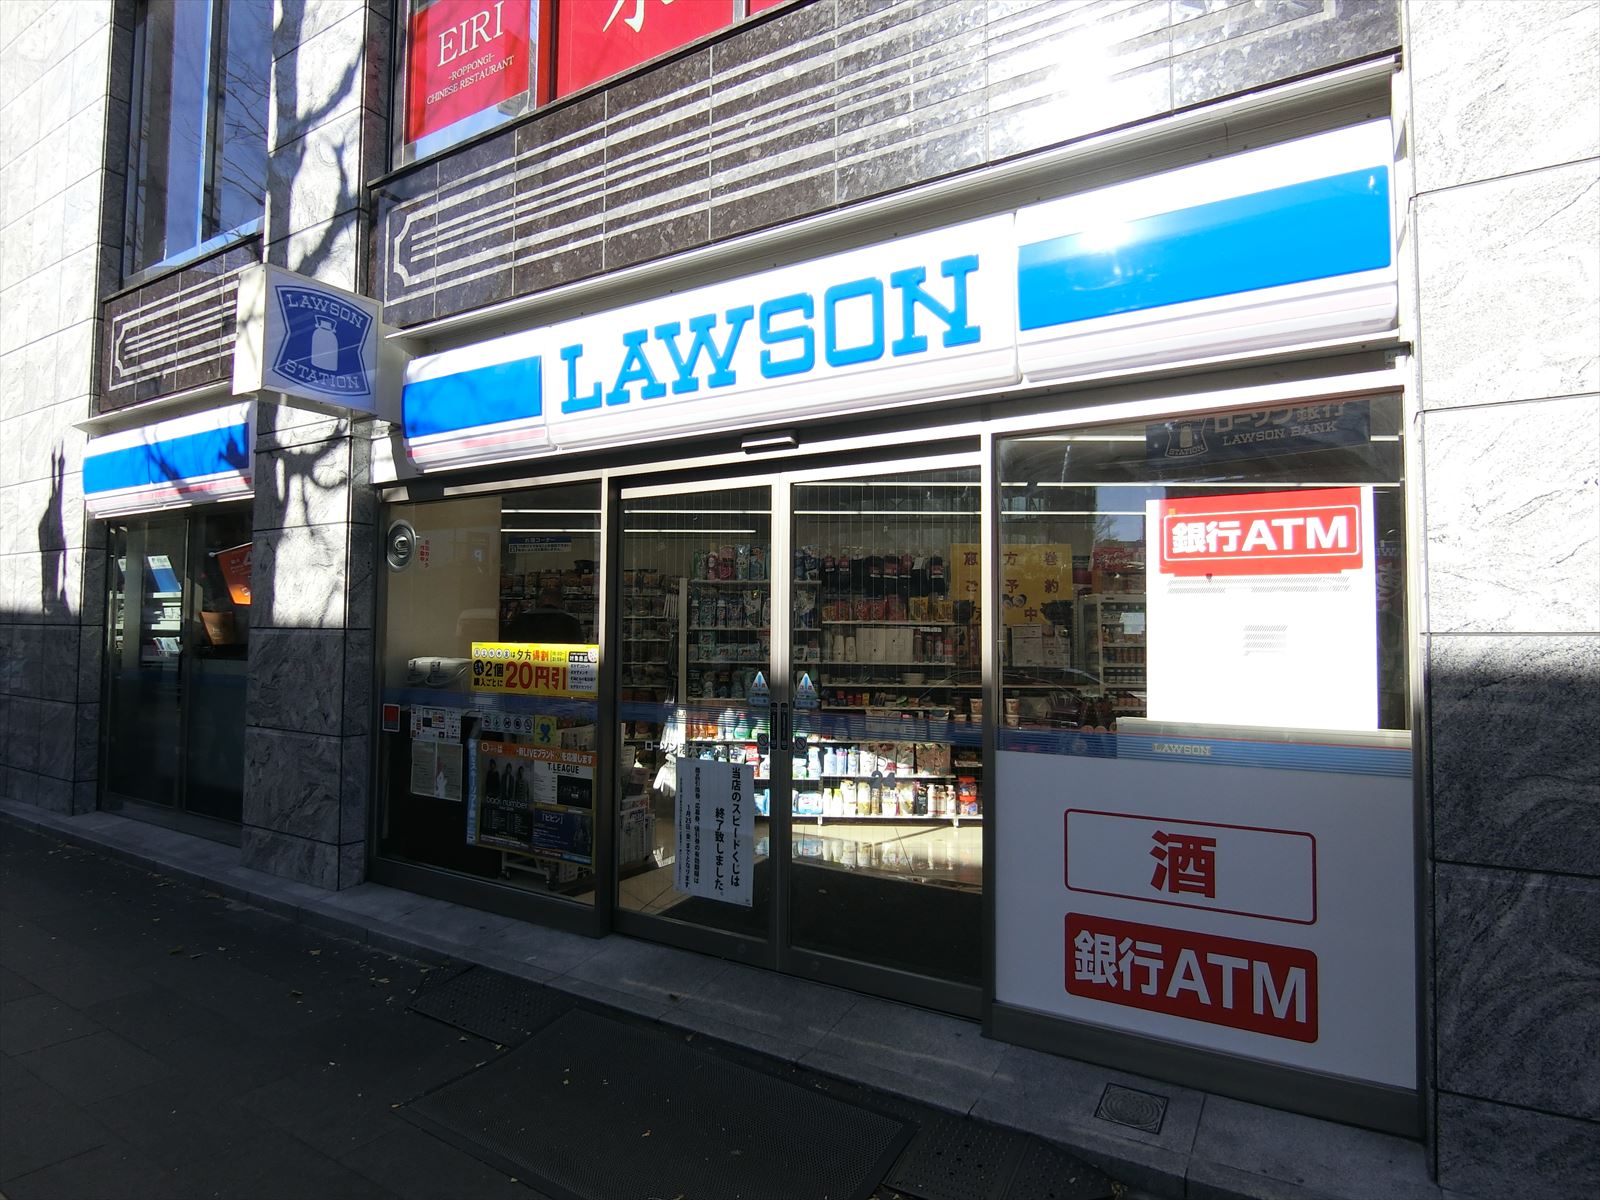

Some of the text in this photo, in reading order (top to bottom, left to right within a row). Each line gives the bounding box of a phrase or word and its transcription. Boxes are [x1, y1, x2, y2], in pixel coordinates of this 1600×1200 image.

[437, 1, 504, 67] EIRI
[427, 55, 515, 105] CHINESE RESTAURANT
[286, 293, 364, 329] LAWSON
[560, 254, 981, 415] LAWSON
[284, 359, 360, 389] STATION
[1168, 444, 1205, 456] STATION
[1223, 420, 1338, 446] LAWSON BANK
[1171, 515, 1349, 554] 銀行ATM
[505, 661, 566, 690] 20円引
[1152, 743, 1212, 756] LAWSON
[502, 797, 529, 809] number
[731, 767, 742, 888] 当店のスピードくじは
[1149, 829, 1217, 899] 酒
[1073, 929, 1307, 1024] 銀行ATM
